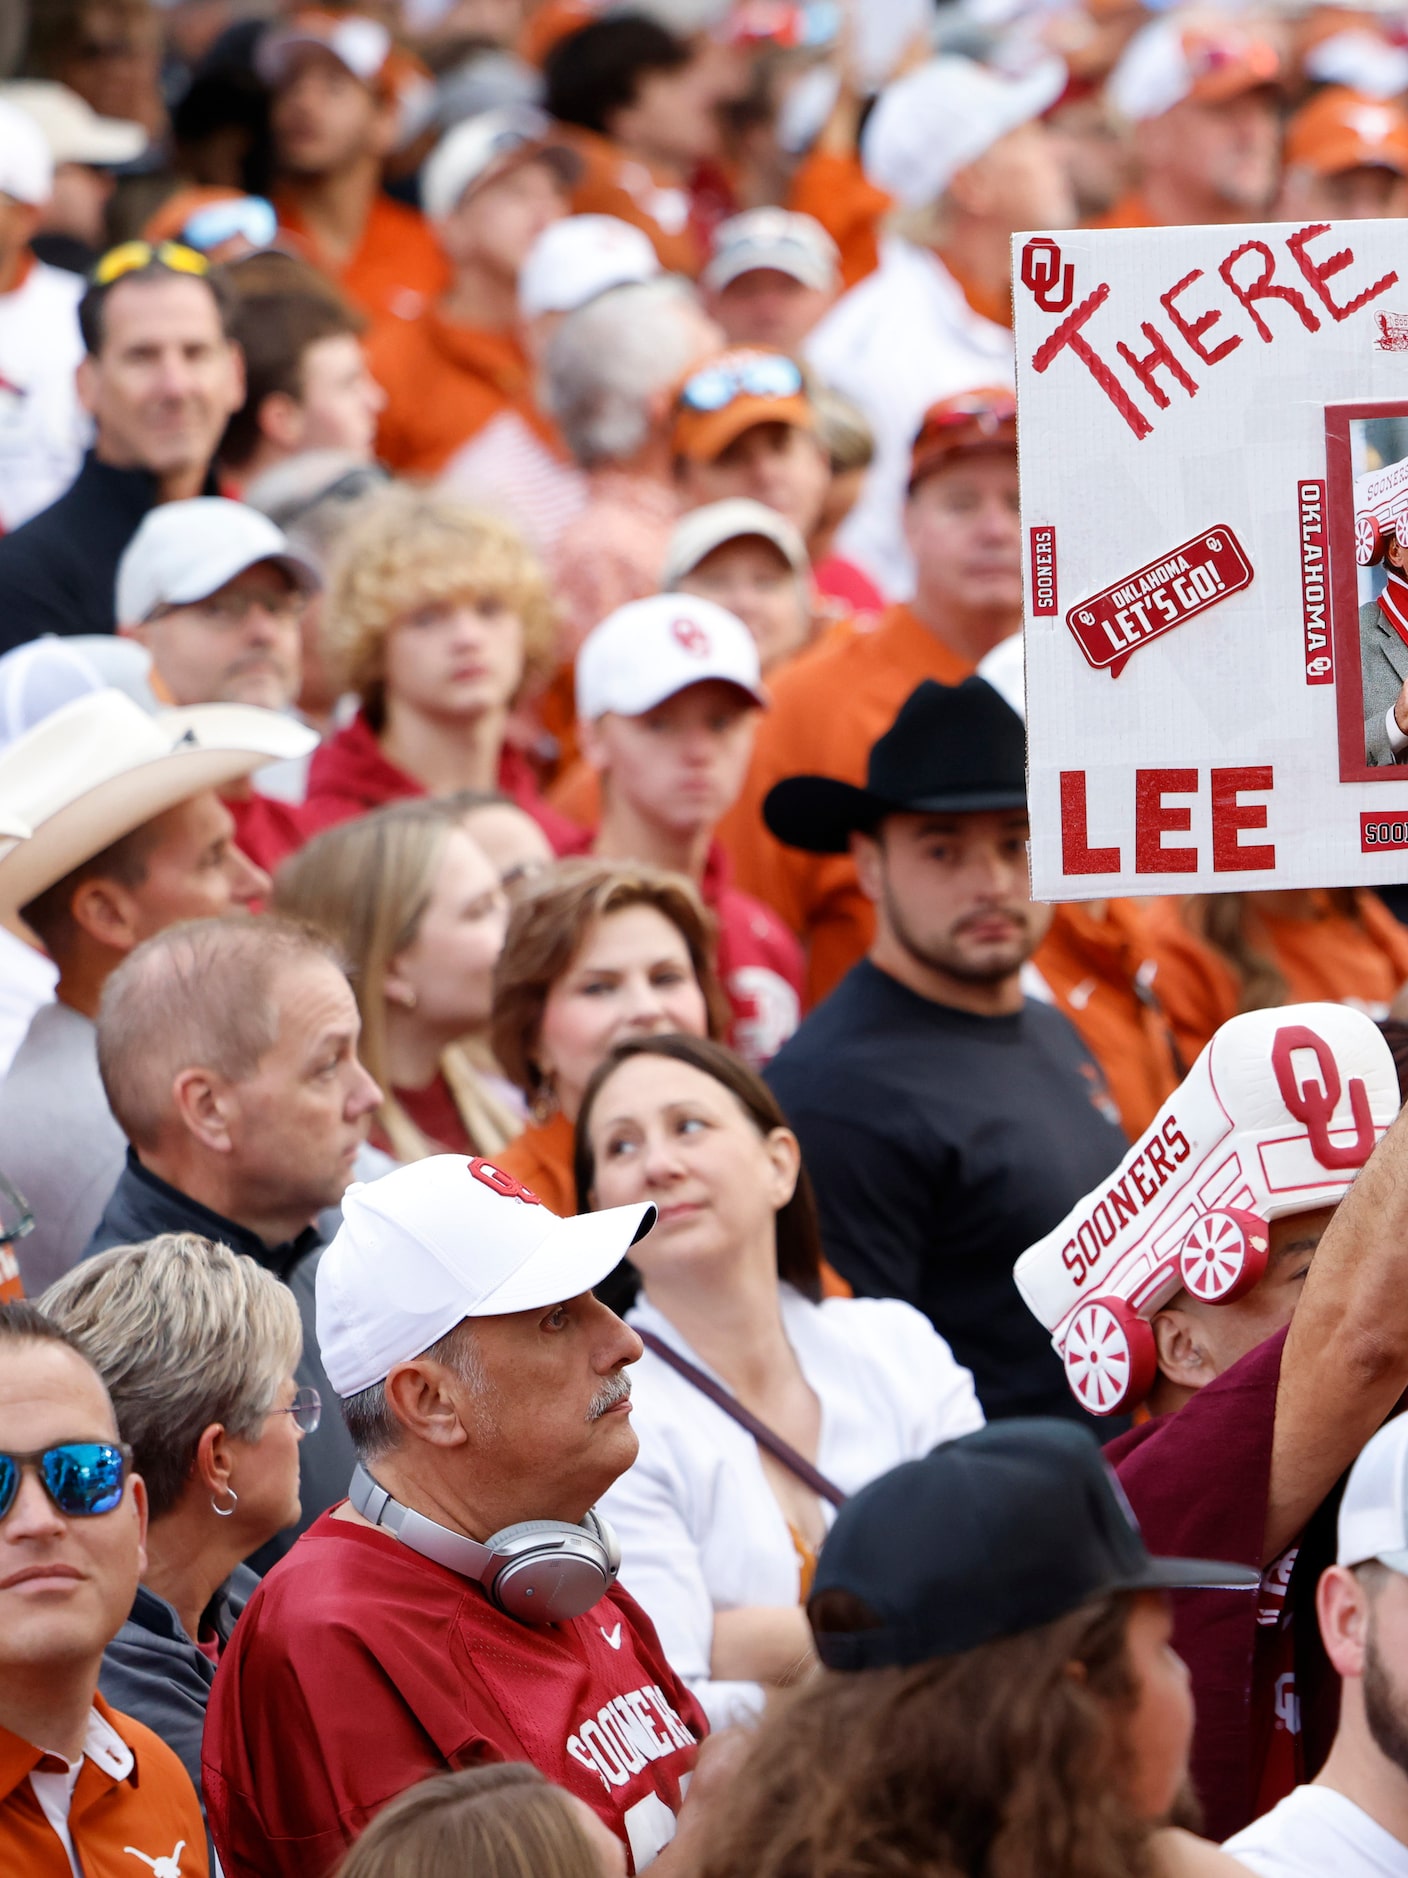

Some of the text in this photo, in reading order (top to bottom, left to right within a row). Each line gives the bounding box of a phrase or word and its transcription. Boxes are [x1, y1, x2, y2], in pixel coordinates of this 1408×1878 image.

[1021, 237, 1074, 313] OU
[1032, 224, 1398, 440] THERE
[1035, 532, 1054, 608] SOONERS
[1101, 559, 1226, 651] LET'S GO!
[1111, 555, 1191, 609] OKLAHOMA
[1300, 484, 1327, 652] OKLAHOMA
[1060, 765, 1276, 876] LEE
[1271, 1025, 1376, 1170] OU
[1061, 1115, 1190, 1287] SOONERS
